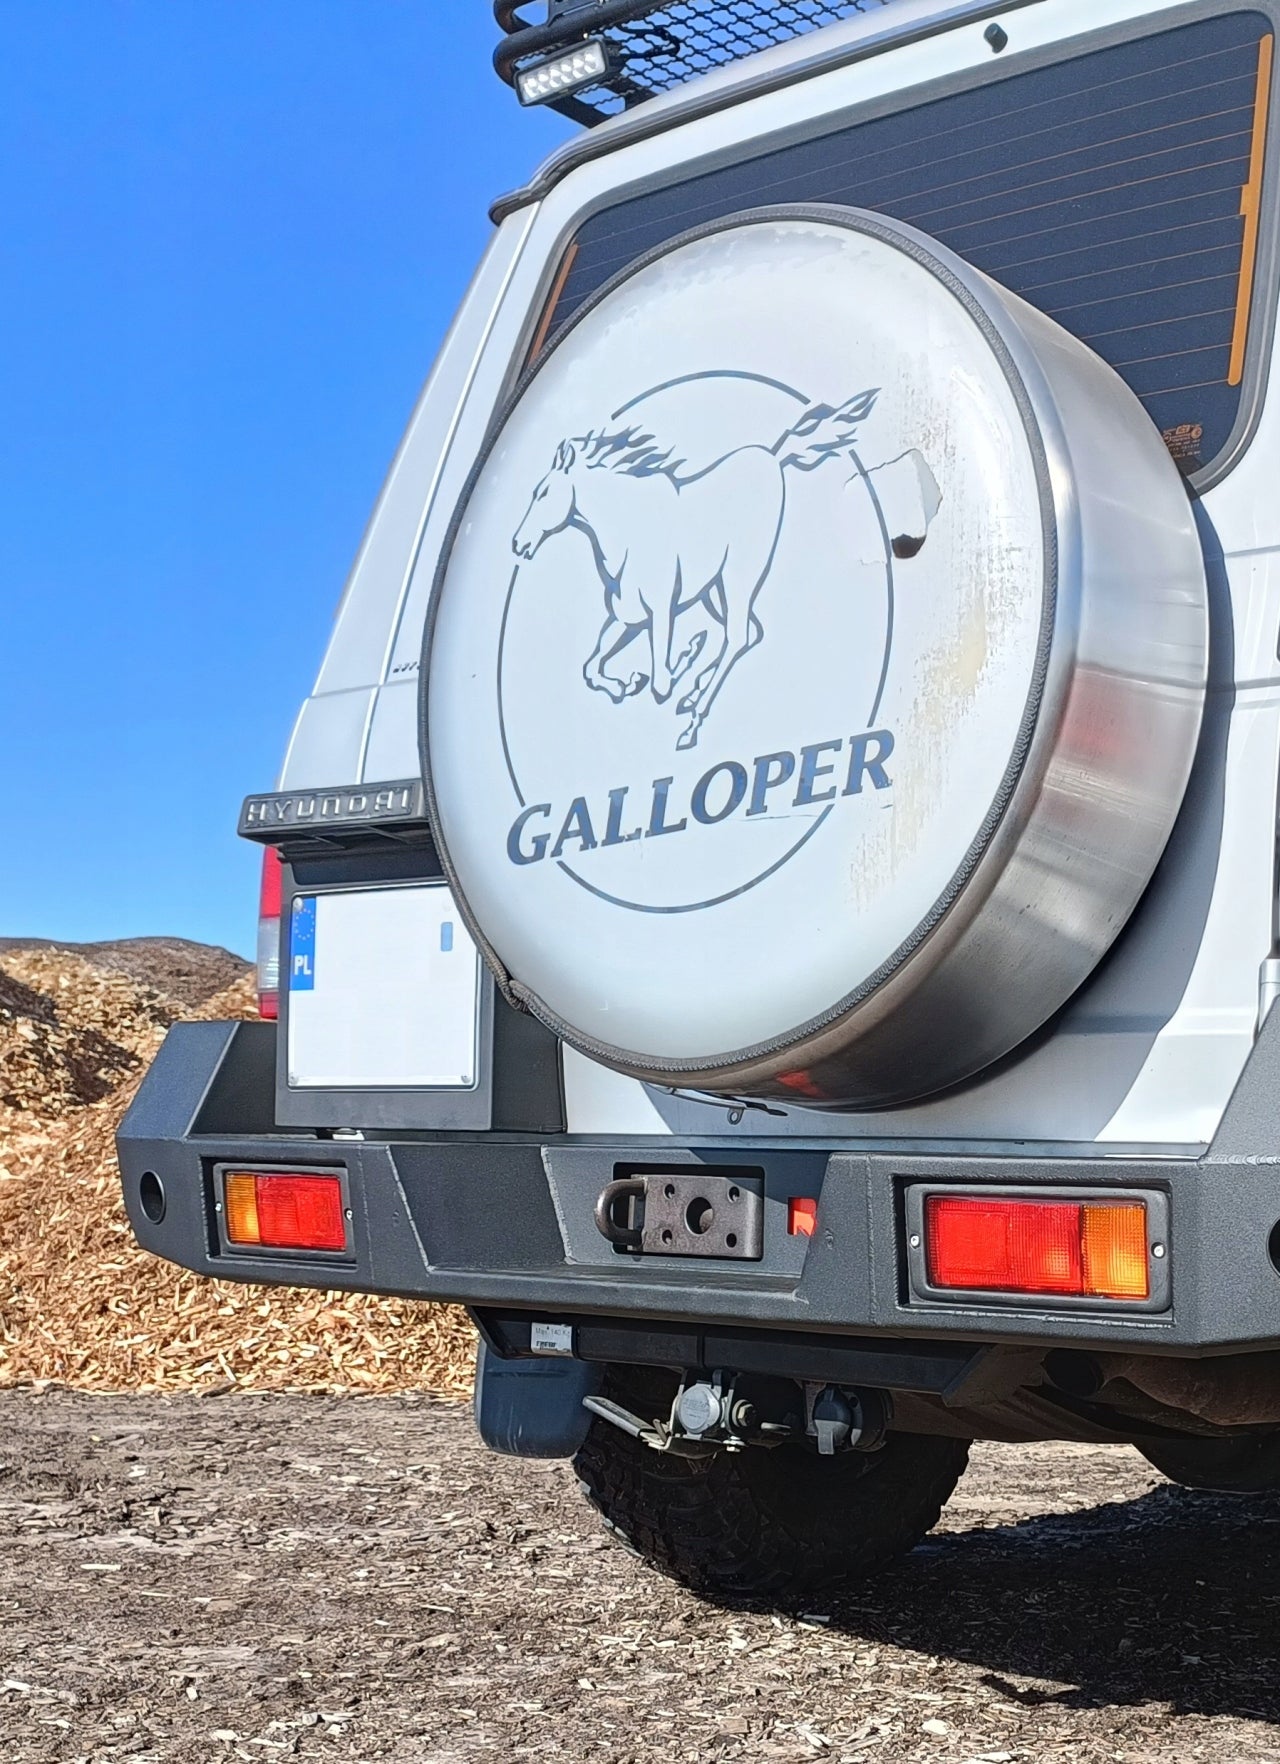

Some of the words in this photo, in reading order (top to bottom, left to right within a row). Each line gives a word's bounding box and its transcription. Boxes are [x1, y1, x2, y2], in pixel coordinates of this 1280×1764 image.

[247, 788, 410, 822] HYUNDAI
[506, 728, 896, 866] GALLOPER
[293, 955, 312, 976] PL
